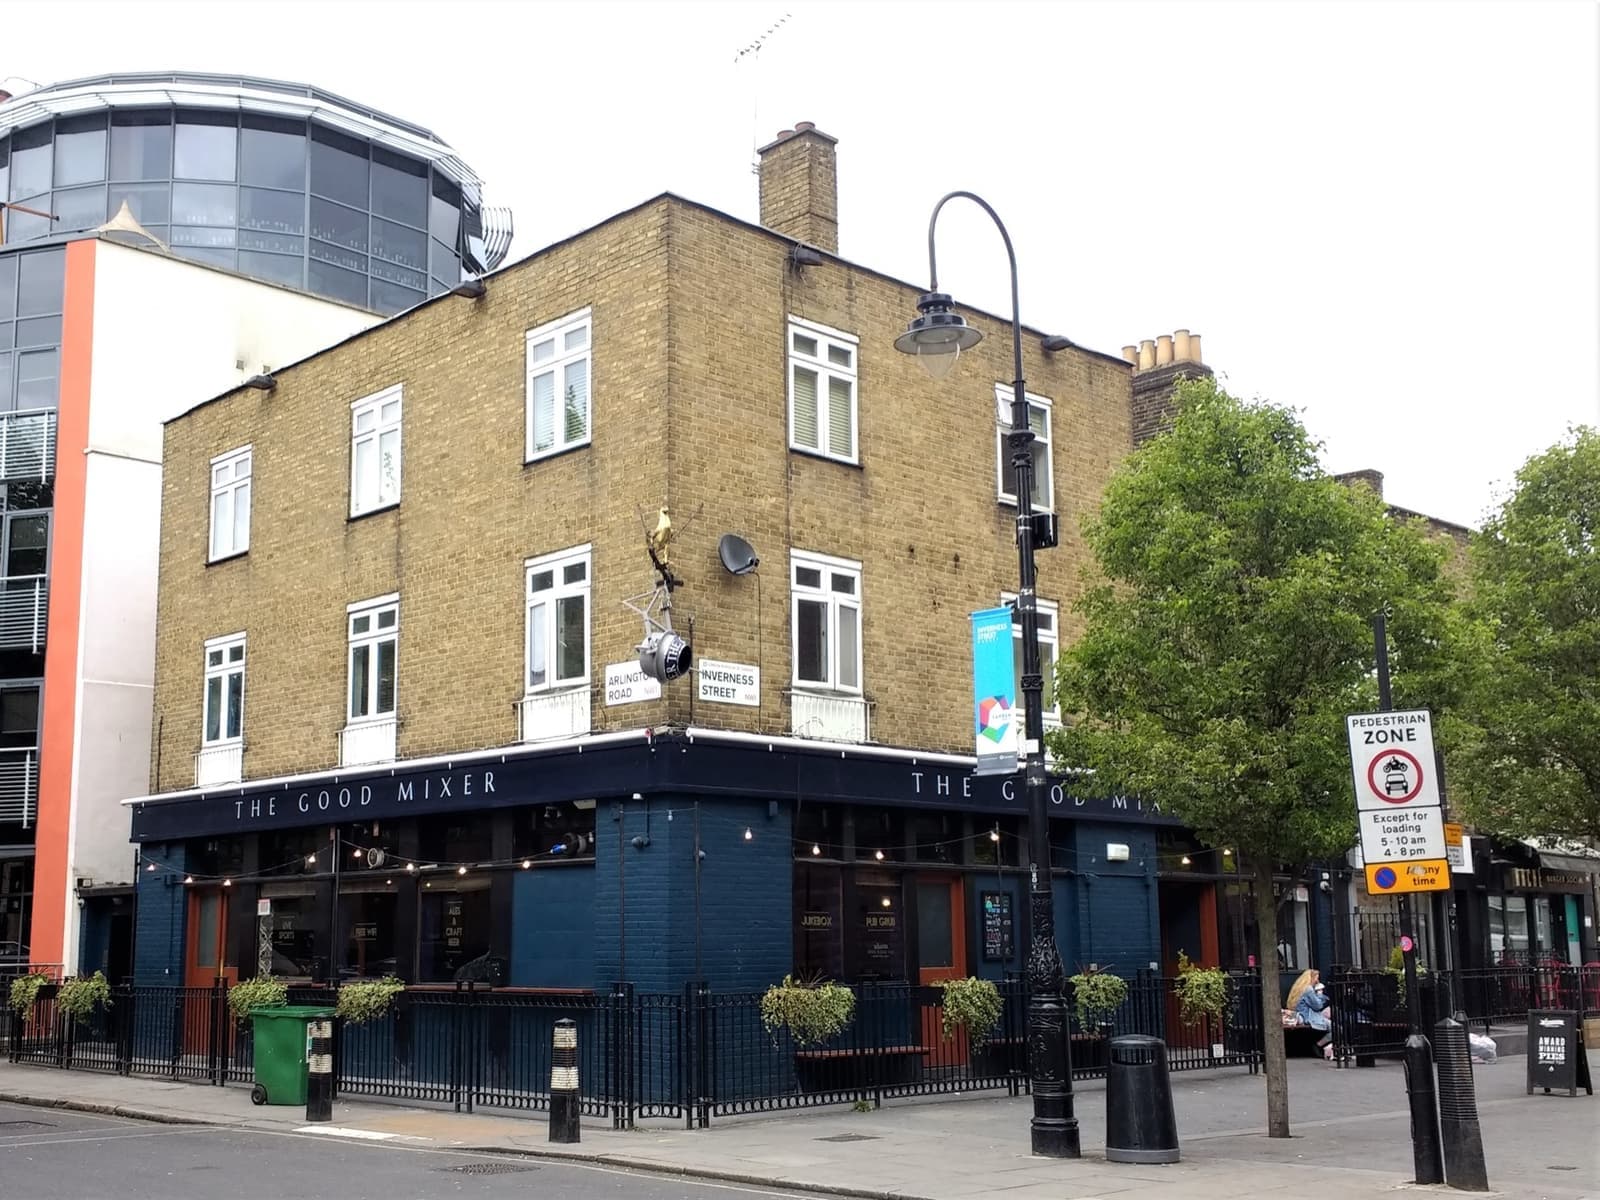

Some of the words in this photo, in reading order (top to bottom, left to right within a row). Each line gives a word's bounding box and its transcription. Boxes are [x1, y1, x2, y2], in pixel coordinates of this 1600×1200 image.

[608, 671, 651, 687] ARLINGTO
[701, 669, 755, 686] INVERNESS
[608, 687, 632, 701] ROAD
[701, 685, 737, 699] STREET
[1352, 714, 1426, 728] PEDESTRIAN
[1363, 728, 1417, 745] ZONE
[234, 796, 277, 820] THE
[298, 785, 372, 813] GOOD
[397, 771, 496, 802] MIXER
[911, 772, 972, 798] THE
[1002, 780, 1086, 807] GO
[1373, 814, 1409, 824] Except
[1412, 812, 1428, 821] for
[1382, 823, 1422, 835] loading
[1409, 848, 1426, 857] pm
[1412, 876, 1436, 886] time
[801, 915, 833, 927] JUKEBOX
[1538, 1036, 1566, 1046] AWARD
[1538, 1052, 1566, 1061] PIES
